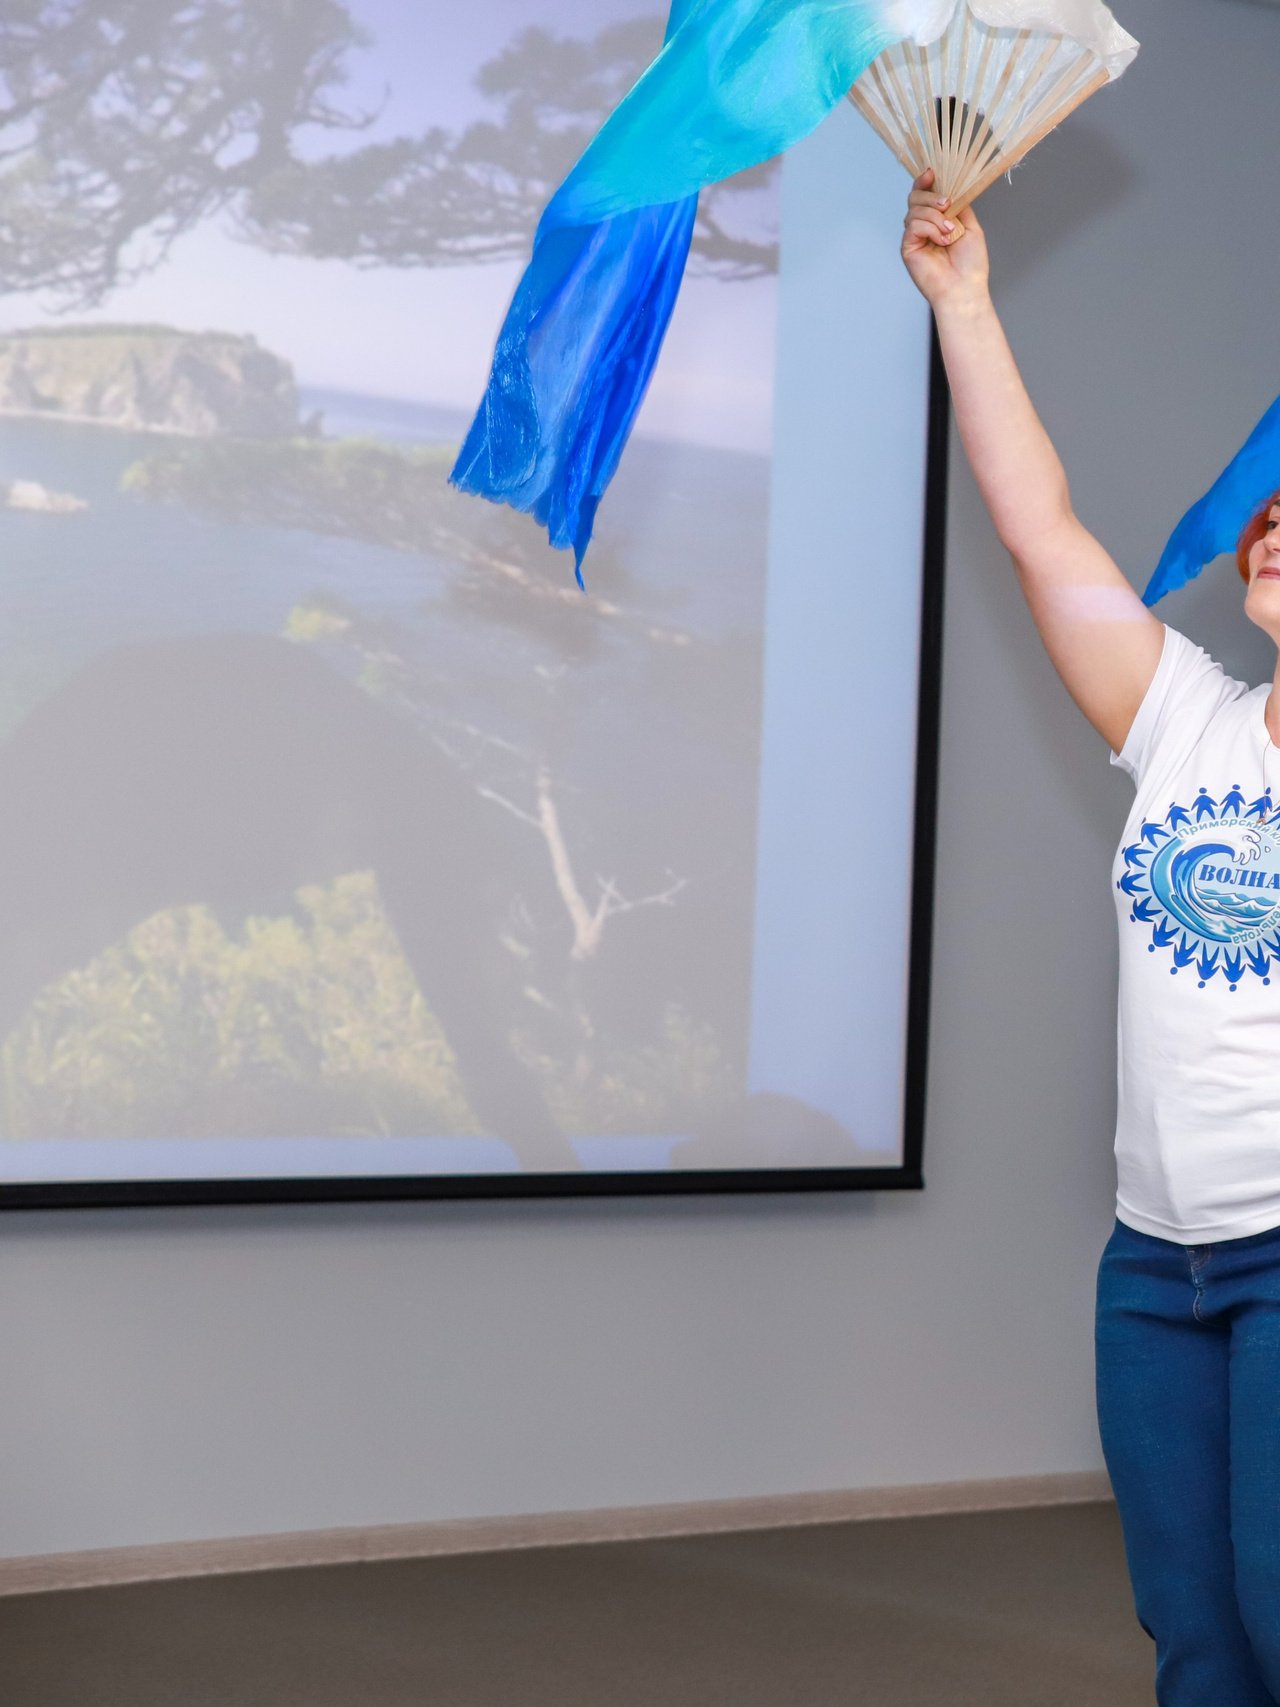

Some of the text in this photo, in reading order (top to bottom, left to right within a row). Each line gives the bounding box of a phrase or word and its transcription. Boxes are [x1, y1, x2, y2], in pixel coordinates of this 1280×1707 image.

[1176, 818, 1271, 838] Приморский
[1232, 929, 1261, 944] года
[1198, 864, 1280, 889] ВОЛНА
